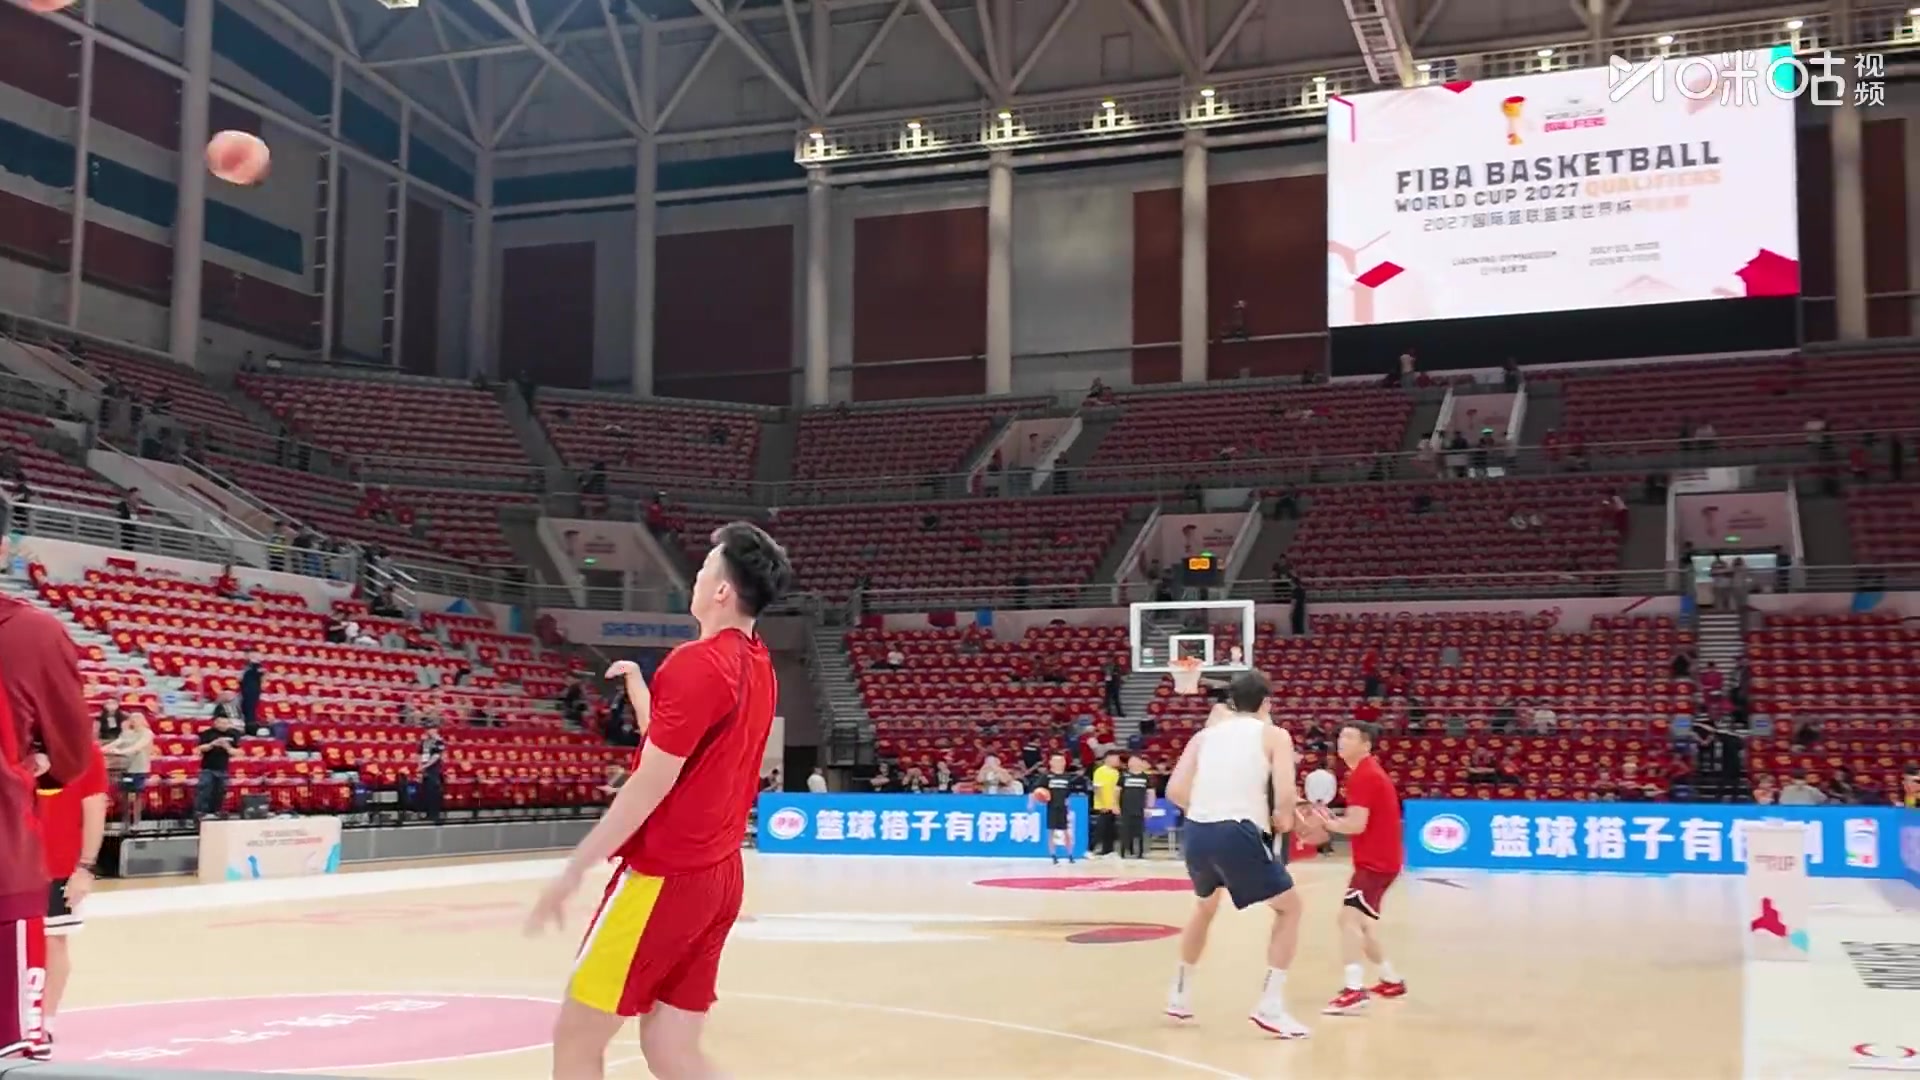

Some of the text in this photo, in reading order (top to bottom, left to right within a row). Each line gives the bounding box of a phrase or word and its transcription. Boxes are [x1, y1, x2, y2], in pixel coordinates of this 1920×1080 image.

[1396, 141, 1721, 194] FIBA BASKETBALL
[1395, 194, 1467, 213] WORLD
[1474, 188, 1517, 207] CUP
[1525, 182, 1579, 201] 2027
[1424, 194, 1690, 232] 2027国际篮联篮球世界杯
[815, 809, 1041, 843] 篮球搭子有伊利
